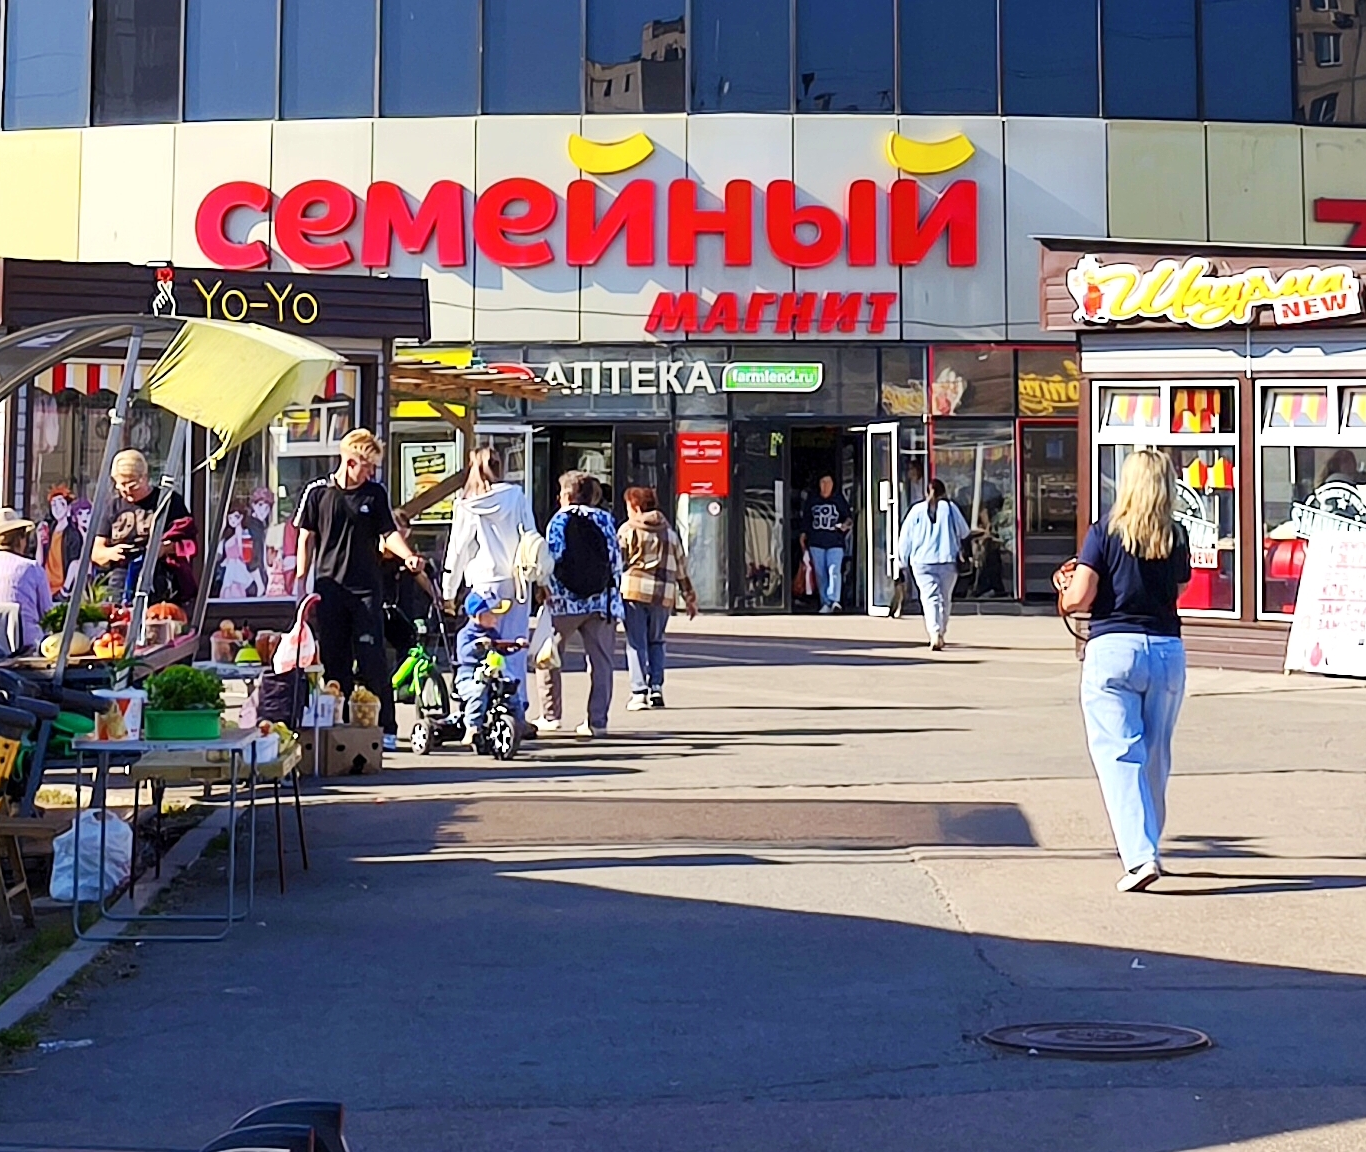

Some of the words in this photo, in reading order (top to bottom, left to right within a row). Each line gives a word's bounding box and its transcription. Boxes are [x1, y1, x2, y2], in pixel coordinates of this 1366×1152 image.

[644, 291, 898, 334] МАГНИТ
[1099, 264, 1346, 325] Шаурма
[1282, 293, 1348, 318] NEW
[543, 360, 717, 395] АПТЕКА
